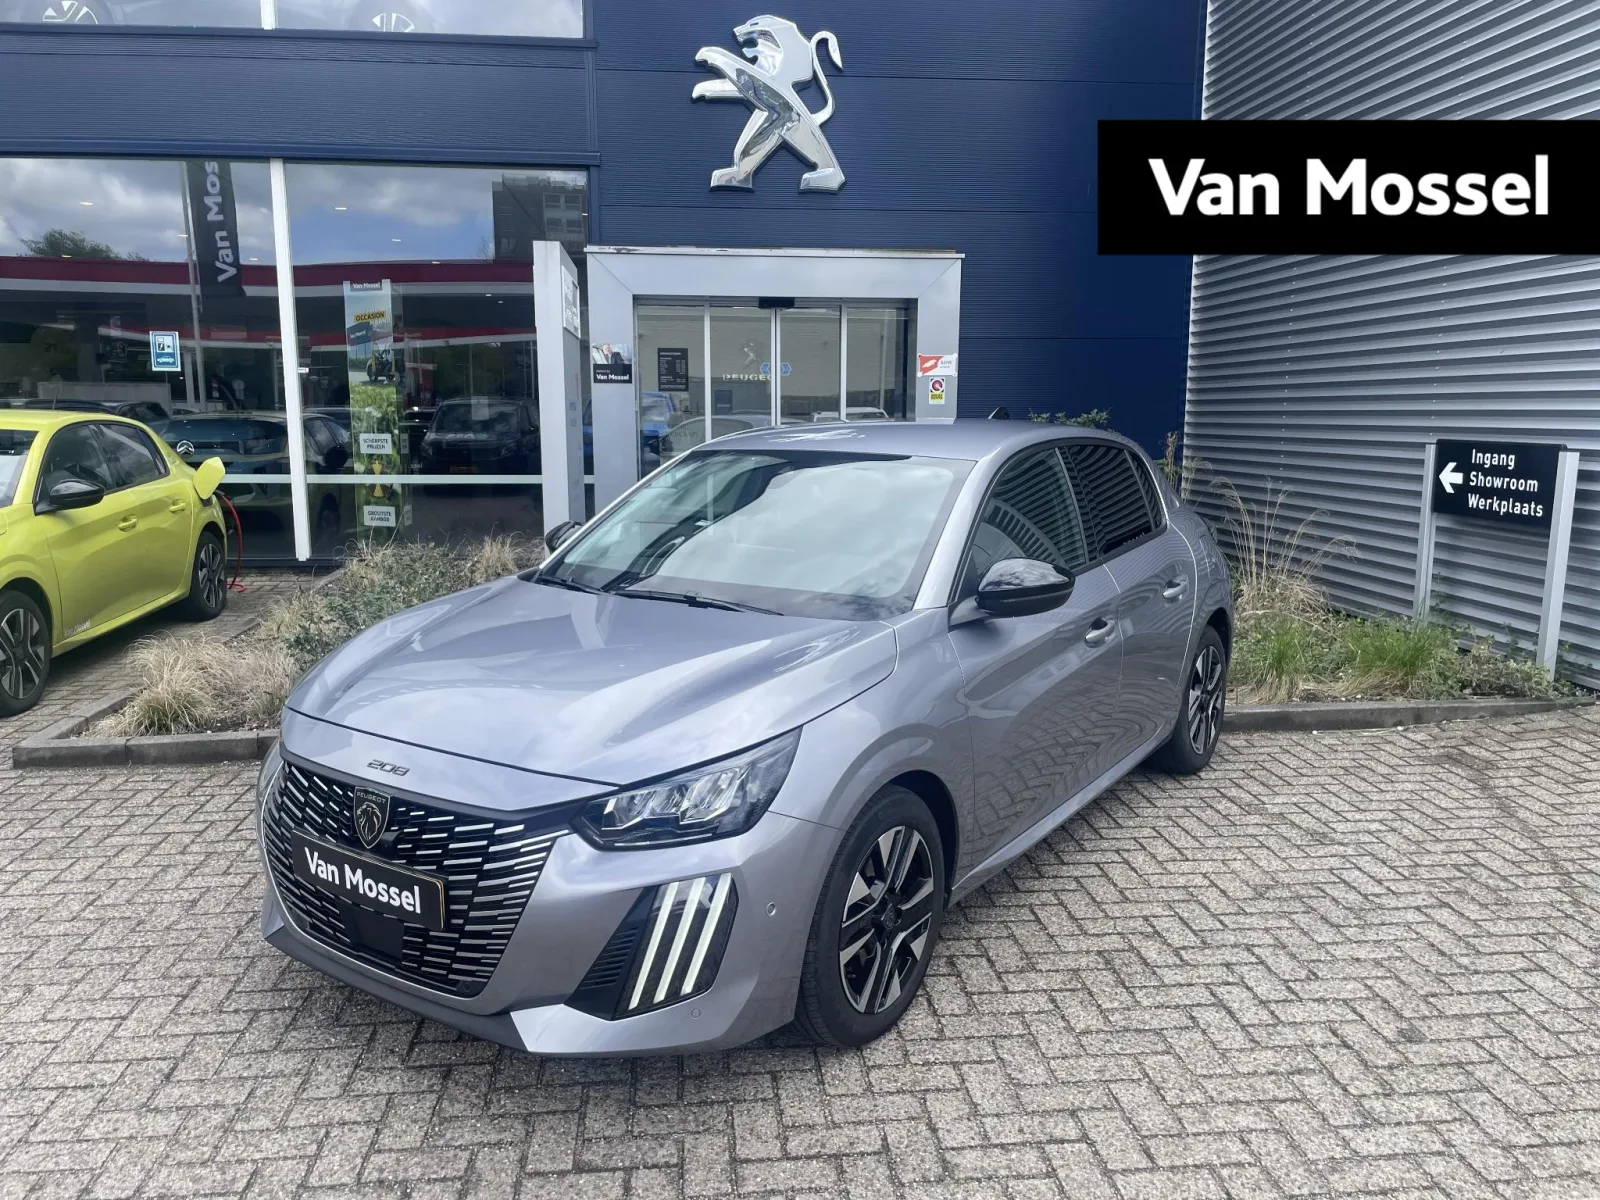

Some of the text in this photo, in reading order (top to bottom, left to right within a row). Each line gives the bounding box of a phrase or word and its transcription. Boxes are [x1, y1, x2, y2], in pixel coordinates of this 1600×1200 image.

[214, 230, 238, 282] Van
[355, 311, 385, 322] OCCASION
[608, 373, 630, 381] Mossel
[1471, 448, 1516, 470] Ingang
[1469, 471, 1539, 493] Showroom
[1467, 493, 1544, 517] Werkplaats
[366, 758, 411, 777] 208
[356, 790, 387, 804] PEUGEOT
[304, 846, 421, 914] Van Mossel
